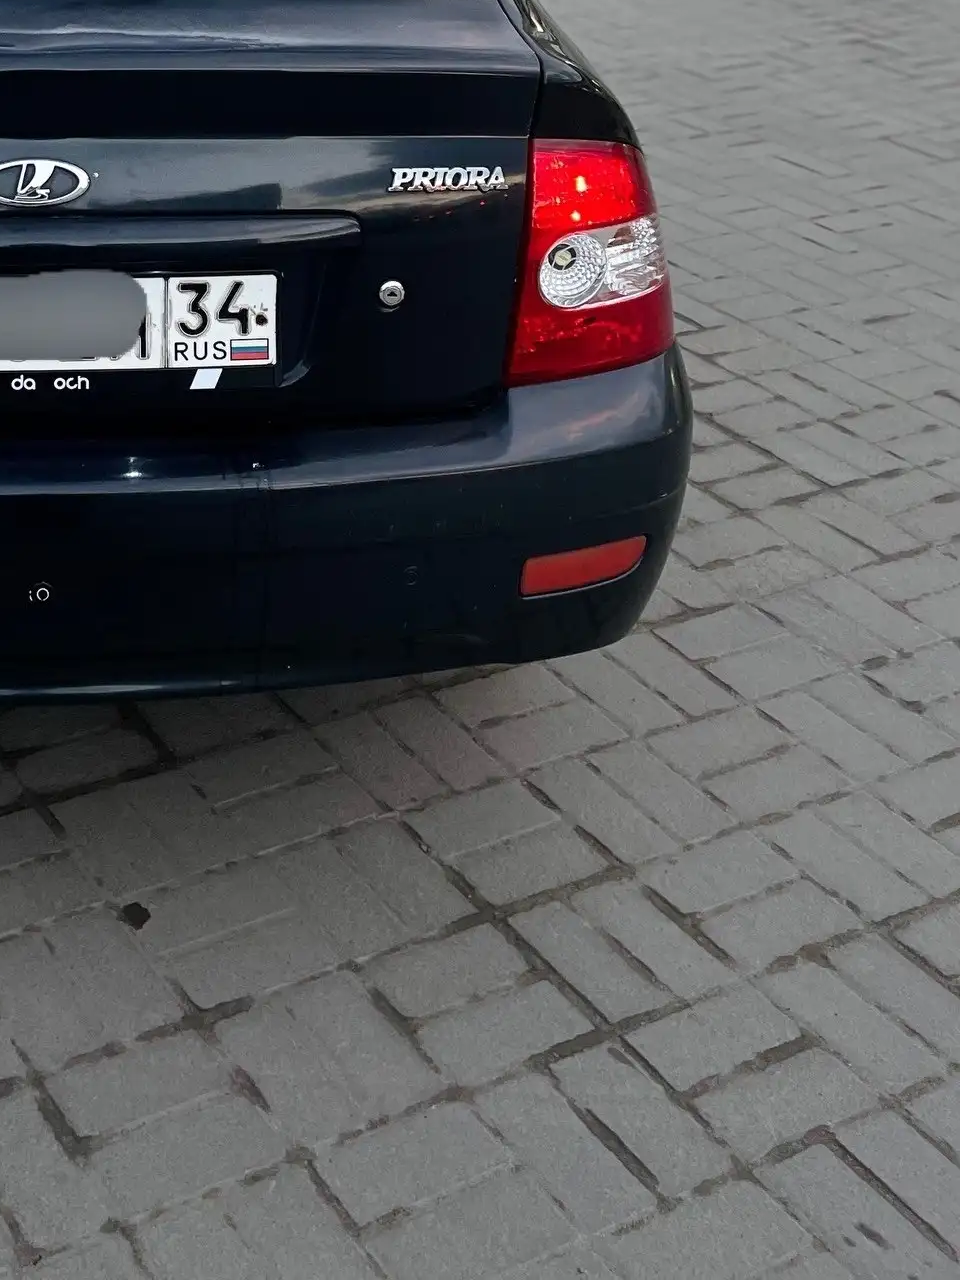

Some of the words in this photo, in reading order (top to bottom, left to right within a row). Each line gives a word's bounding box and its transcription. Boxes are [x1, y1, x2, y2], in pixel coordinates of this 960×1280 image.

[388, 166, 509, 193] PRIORA
[178, 280, 250, 337] 34
[174, 341, 227, 361] RUS
